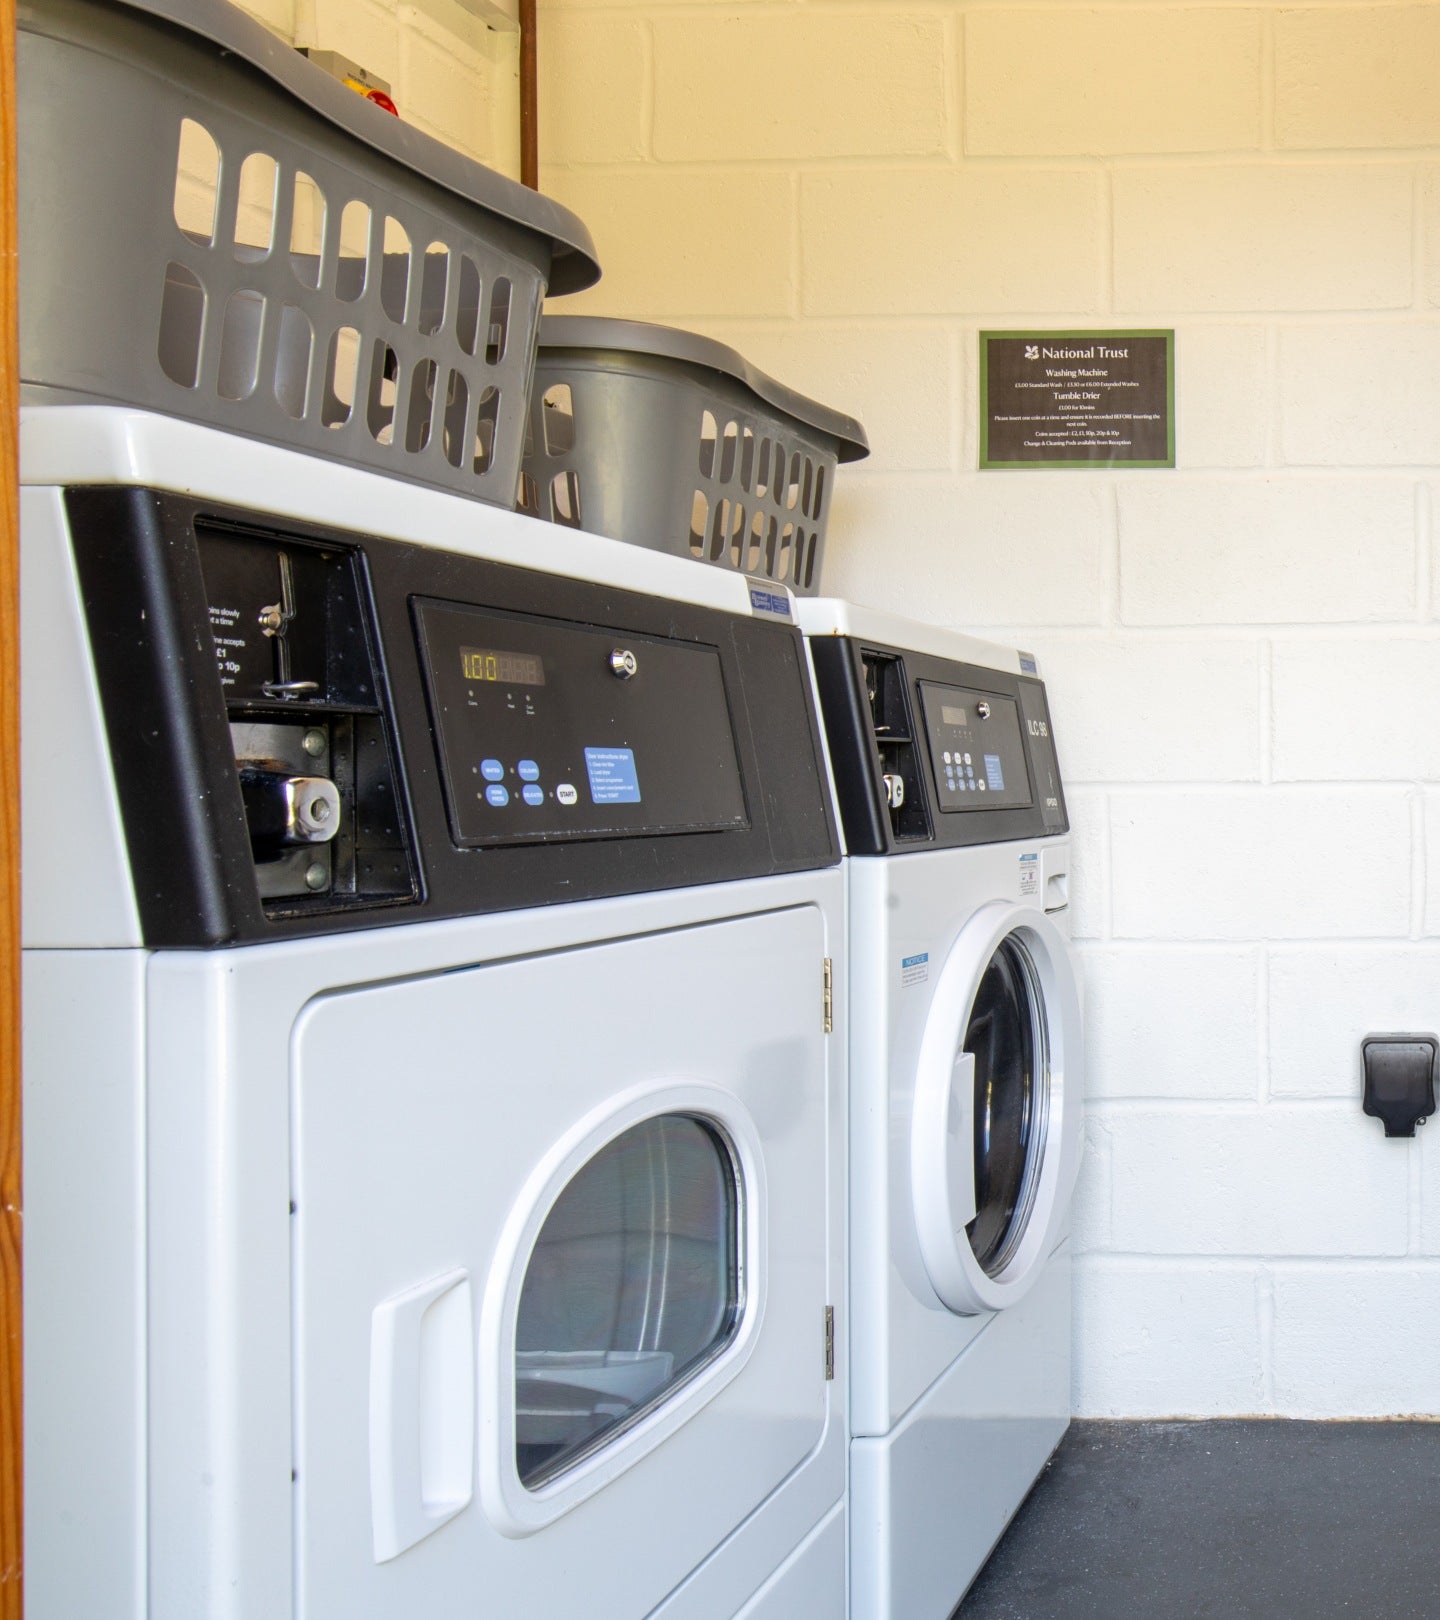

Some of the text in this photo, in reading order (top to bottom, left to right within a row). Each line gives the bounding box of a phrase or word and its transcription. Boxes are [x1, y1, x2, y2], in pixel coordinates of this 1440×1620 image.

[1042, 346, 1128, 359] National Trust
[1046, 368, 1108, 378] Washing Machine
[1053, 392, 1101, 400] Tumble Drier
[220, 608, 240, 619] slowly
[220, 617, 234, 626] time
[223, 638, 246, 648] accepts
[216, 648, 226, 658] £1
[224, 660, 240, 674] 10p
[1027, 719, 1040, 736] ILC
[903, 954, 927, 967] NOTICE
